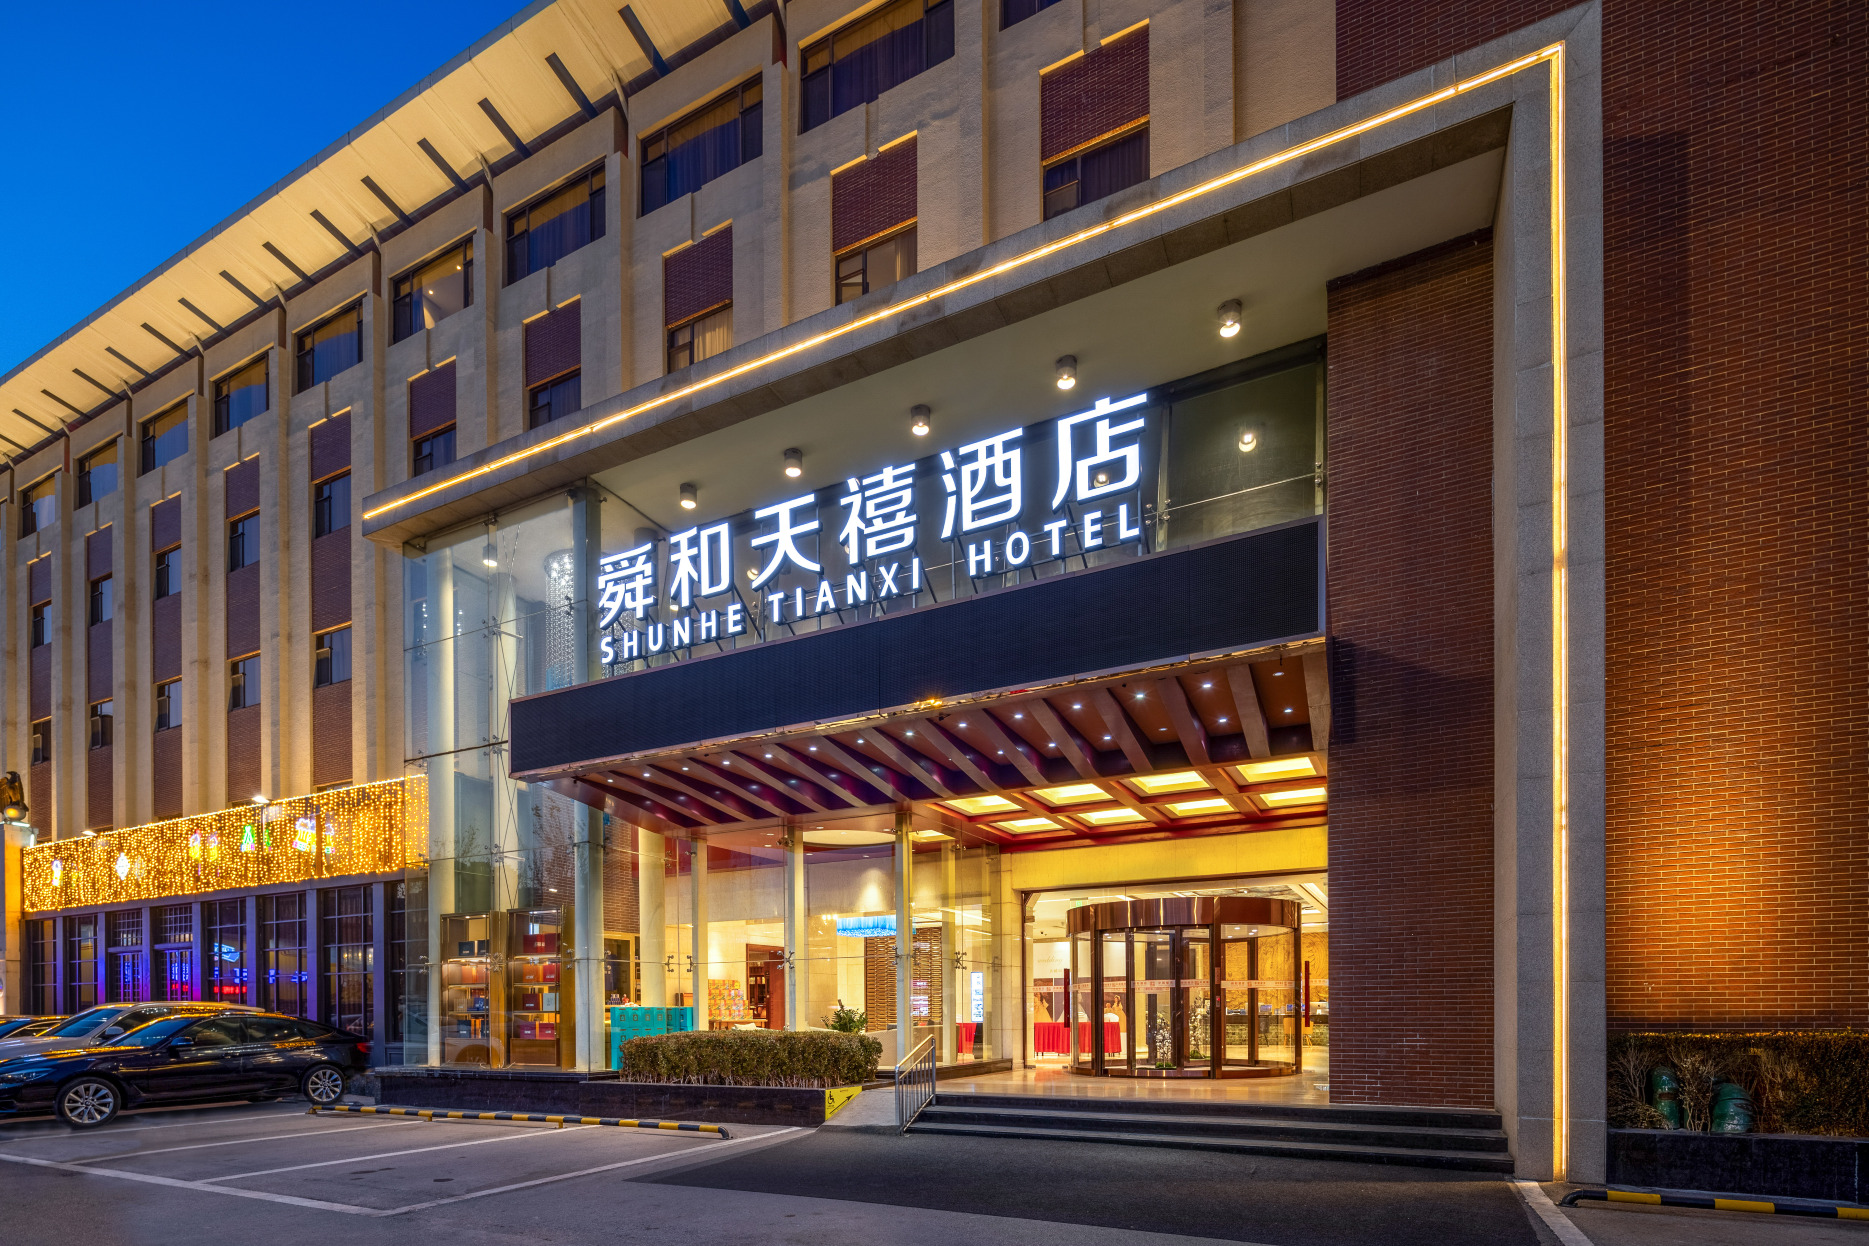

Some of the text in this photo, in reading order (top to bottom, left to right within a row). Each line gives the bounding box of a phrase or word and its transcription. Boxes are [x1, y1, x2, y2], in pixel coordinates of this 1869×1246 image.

[598, 392, 1148, 630] 舜和天禧酒店
[600, 503, 1141, 665] SHUNHE TIANXI HOTEL
